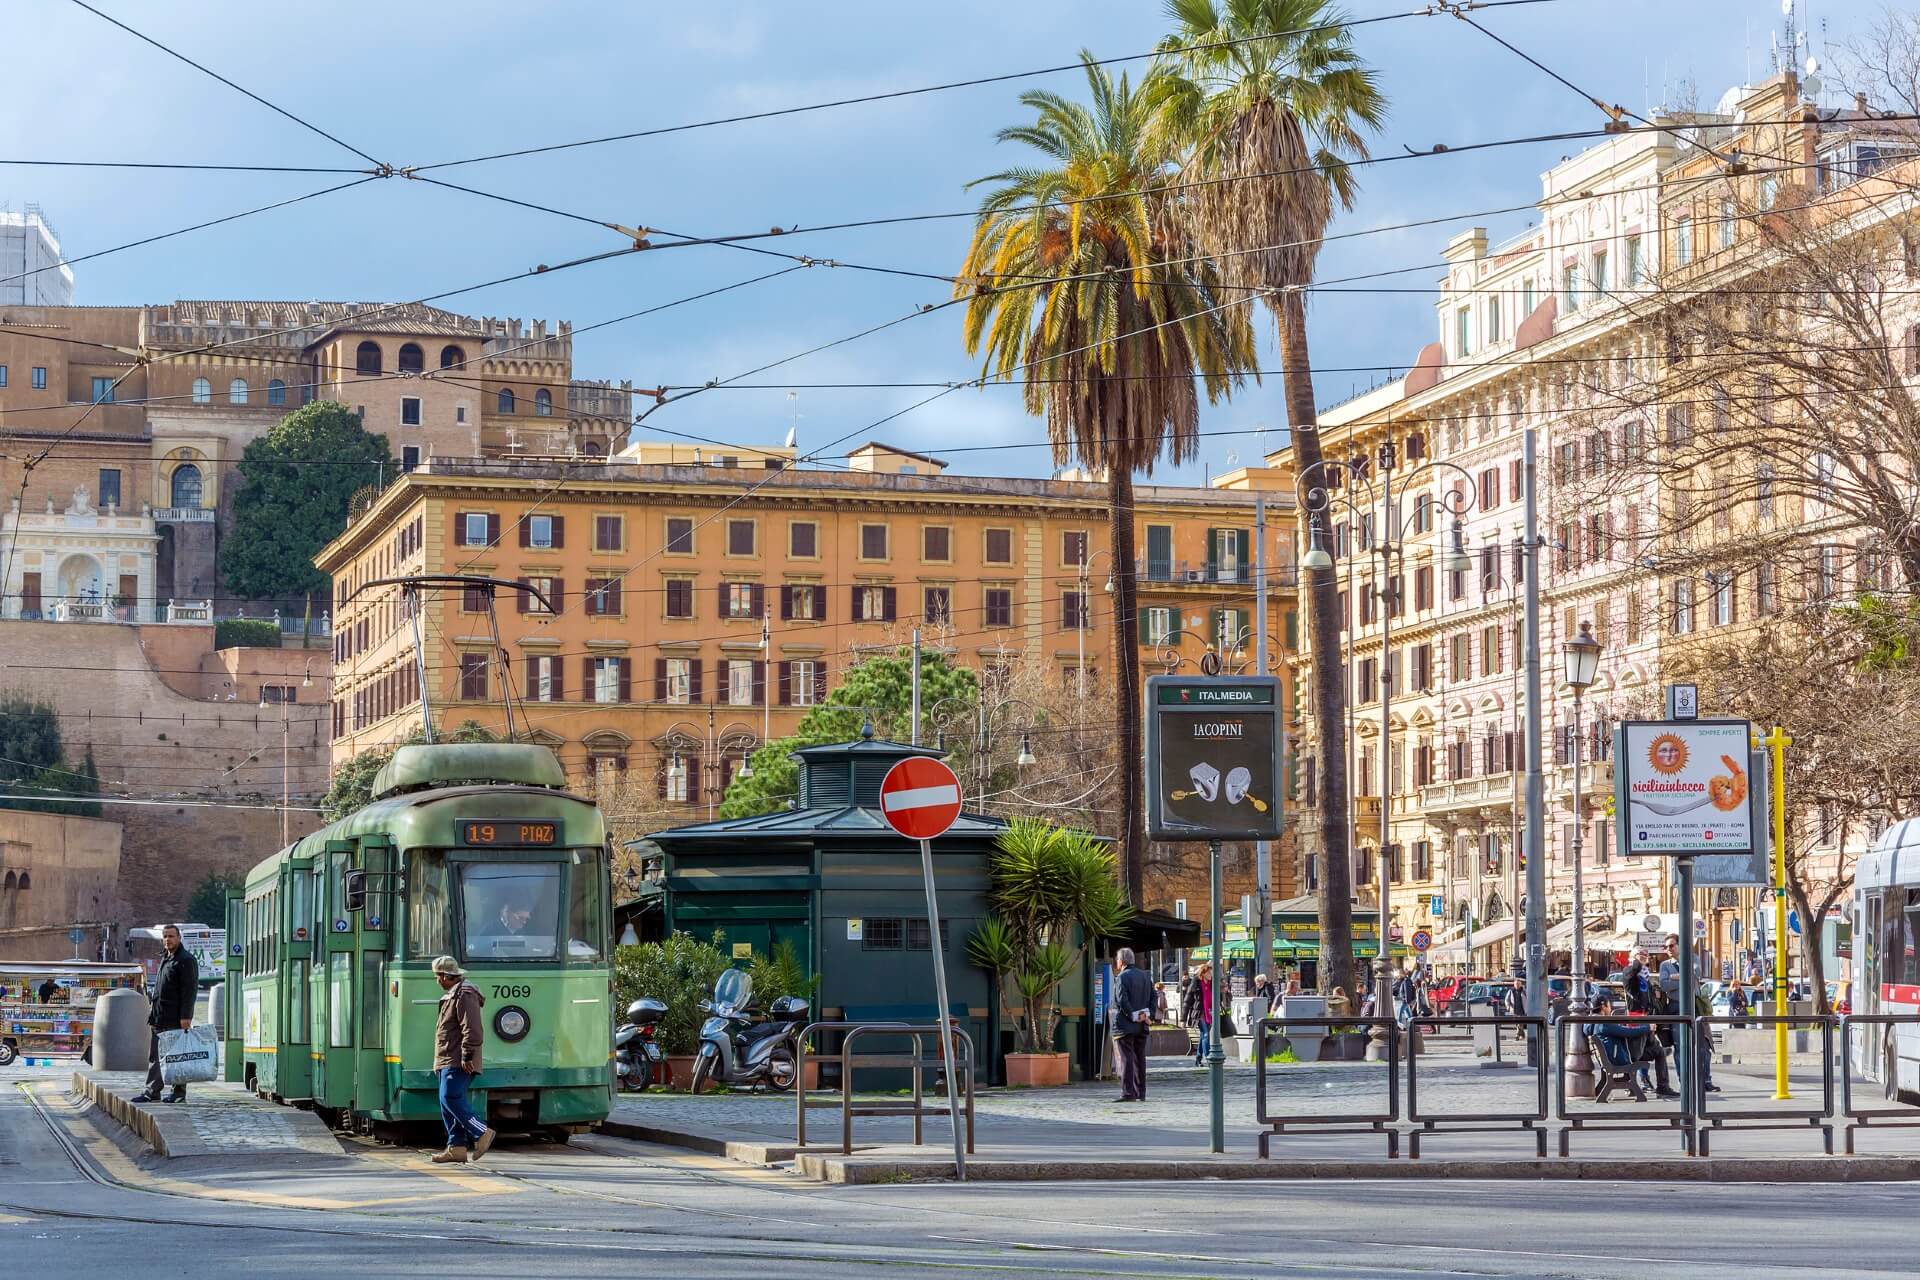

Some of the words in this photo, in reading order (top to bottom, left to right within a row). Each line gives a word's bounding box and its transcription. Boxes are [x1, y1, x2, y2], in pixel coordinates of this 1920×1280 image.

[1199, 691, 1253, 700] ITALMEDIA
[1193, 723, 1242, 736] IACOPINI
[1632, 778, 1705, 792] siciliainbocca
[469, 825, 495, 842] 19
[491, 985, 531, 999] 7069
